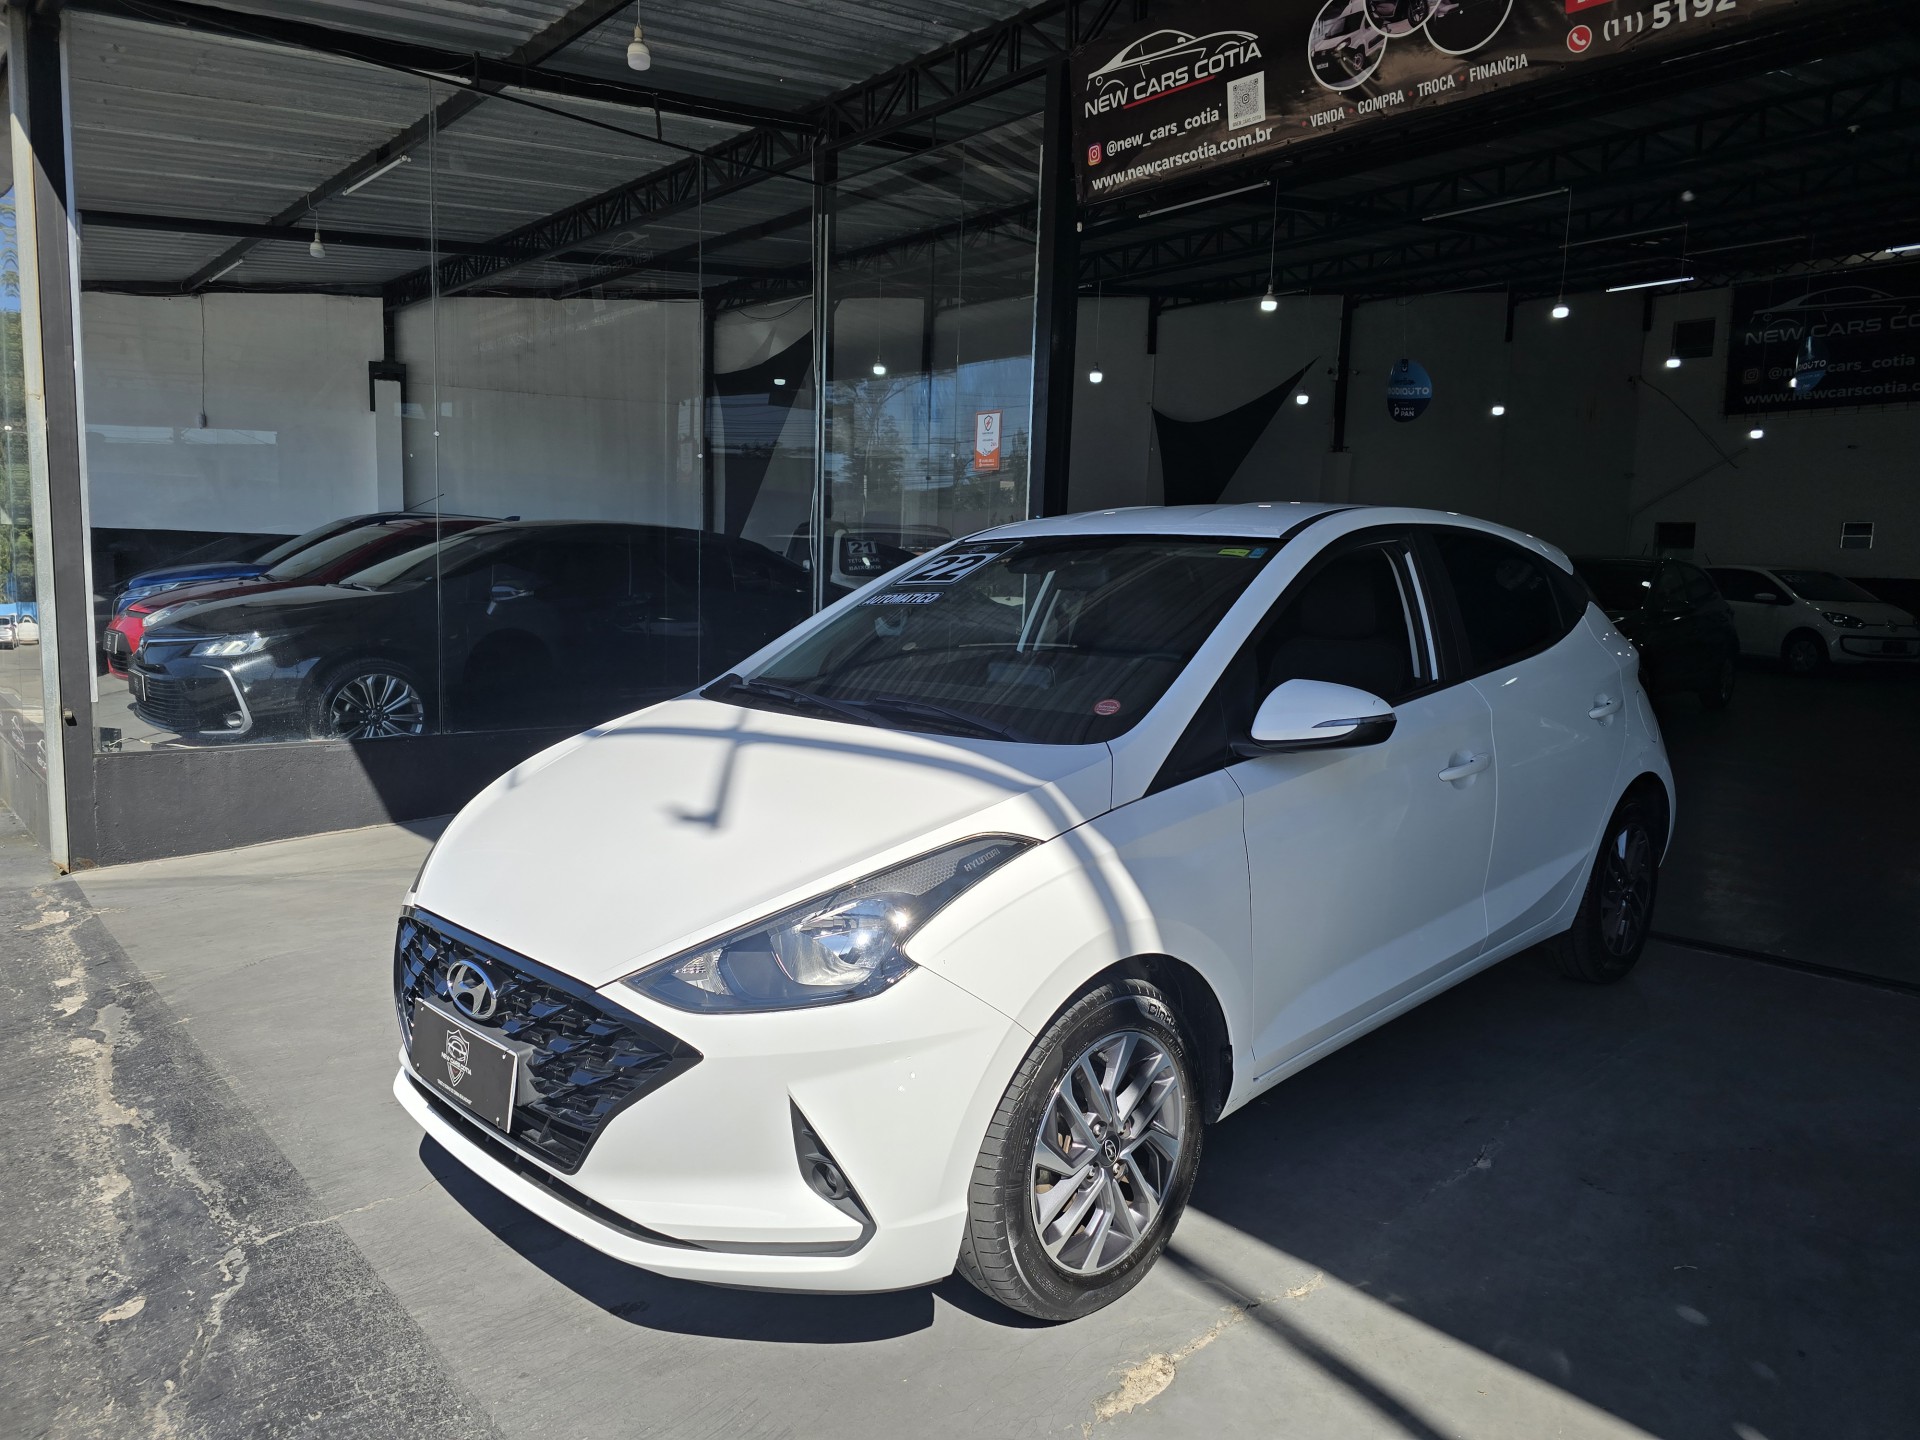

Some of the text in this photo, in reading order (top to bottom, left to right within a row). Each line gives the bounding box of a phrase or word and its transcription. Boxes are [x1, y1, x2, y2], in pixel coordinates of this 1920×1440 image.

[1603, 11, 1643, 42] (11)
[1084, 42, 1262, 119] NEW CARS COTIA
[1309, 53, 1528, 128] VENDA COMPRA TROCA FINANCIA
[1106, 106, 1220, 156] @new_cars_cotia
[1091, 126, 1273, 191] www.newcarscotia.com.br
[1744, 326, 1804, 346] NEW
[1810, 318, 1882, 338] CARS
[850, 542, 874, 554] 21
[904, 554, 988, 583] 22
[963, 847, 1001, 872] HYUNDAI
